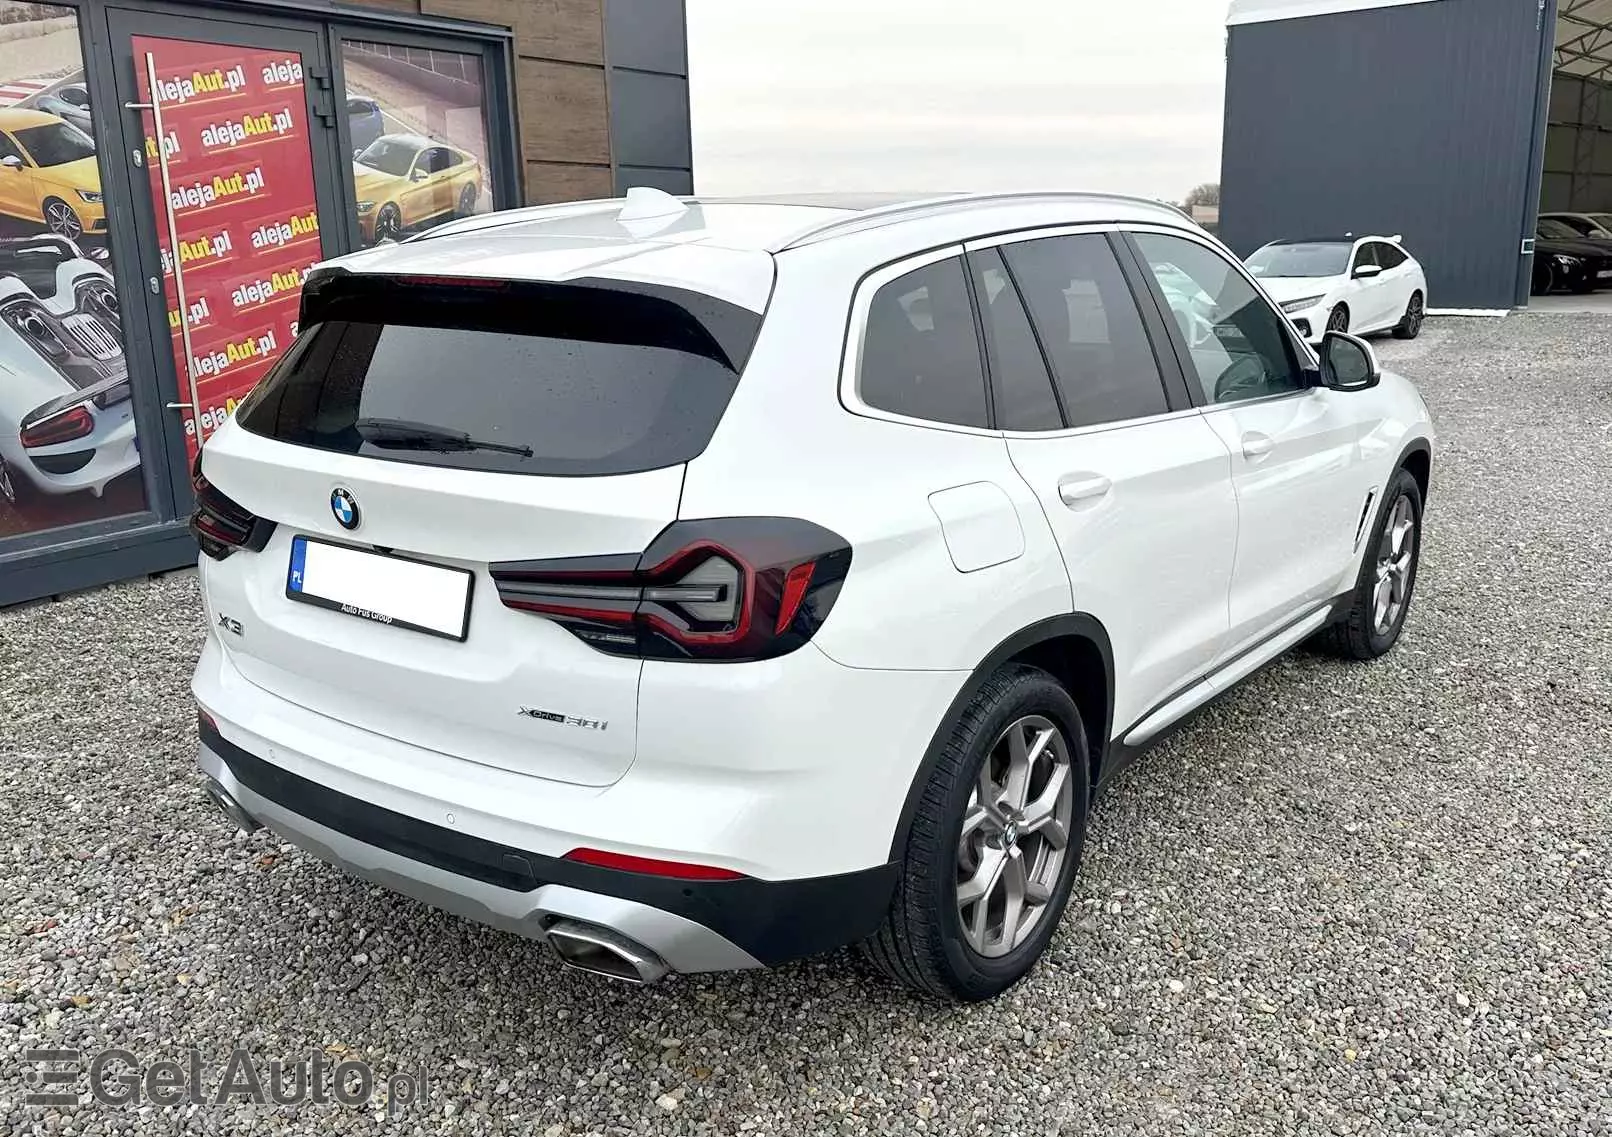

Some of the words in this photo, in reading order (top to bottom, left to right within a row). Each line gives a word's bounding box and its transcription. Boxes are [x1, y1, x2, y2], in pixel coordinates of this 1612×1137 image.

[262, 60, 303, 84] aleja
[201, 108, 293, 147] alejaAut.pl
[171, 167, 265, 210] alejaAut.pl
[251, 211, 319, 249] alejaAut
[185, 330, 277, 377] lejaAut.pl
[292, 570, 303, 584] PL
[217, 611, 245, 638] X3
[341, 603, 358, 614] Auto
[358, 608, 371, 619] Fus
[371, 611, 394, 625] Group
[566, 715, 609, 731] 30i
